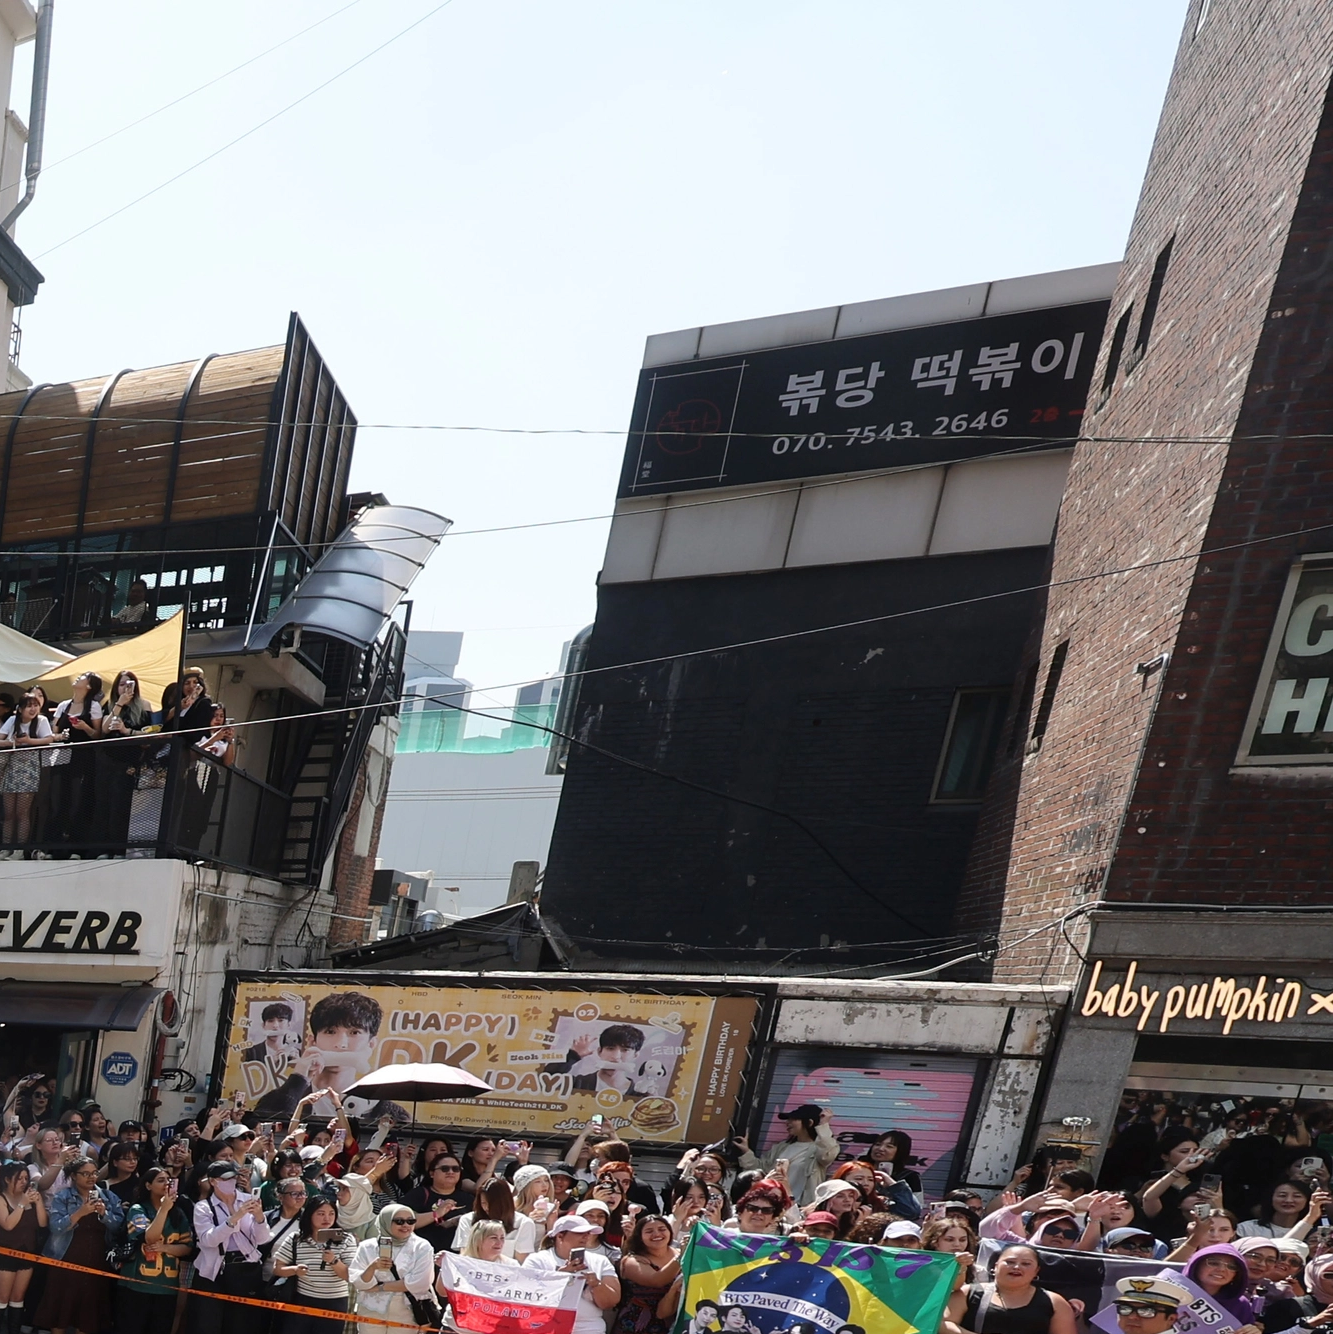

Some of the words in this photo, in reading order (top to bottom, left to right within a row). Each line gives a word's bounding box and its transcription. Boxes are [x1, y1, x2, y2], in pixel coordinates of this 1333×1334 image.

[778, 361, 885, 416] 볶당
[910, 332, 1085, 396] 떡볶이
[772, 432, 833, 455] 070.
[846, 421, 920, 446] 7543.
[932, 408, 1009, 436] 2646
[1081, 960, 1160, 1031] baby
[1159, 976, 1301, 1035] pumpkin
[107, 1063, 133, 1075] ADT
[242, 1053, 290, 1097] DK
[707, 1065, 721, 1096] HAPPY
[714, 1021, 731, 1064] BIRTHDAY
[719, 1084, 727, 1098] LOVE
[724, 1047, 735, 1075] FOREVER
[455, 1097, 477, 1105] FANS
[487, 1100, 562, 1110] WhiteTeeth218_DK
[475, 1271, 502, 1283] BTS
[504, 1289, 543, 1301] ARMY
[473, 1302, 531, 1319] POLAND
[724, 1292, 749, 1305] BTS
[751, 1293, 791, 1310] Paved
[793, 1301, 813, 1316] The
[815, 1309, 840, 1330] Way
[1189, 1298, 1222, 1324] BTS
